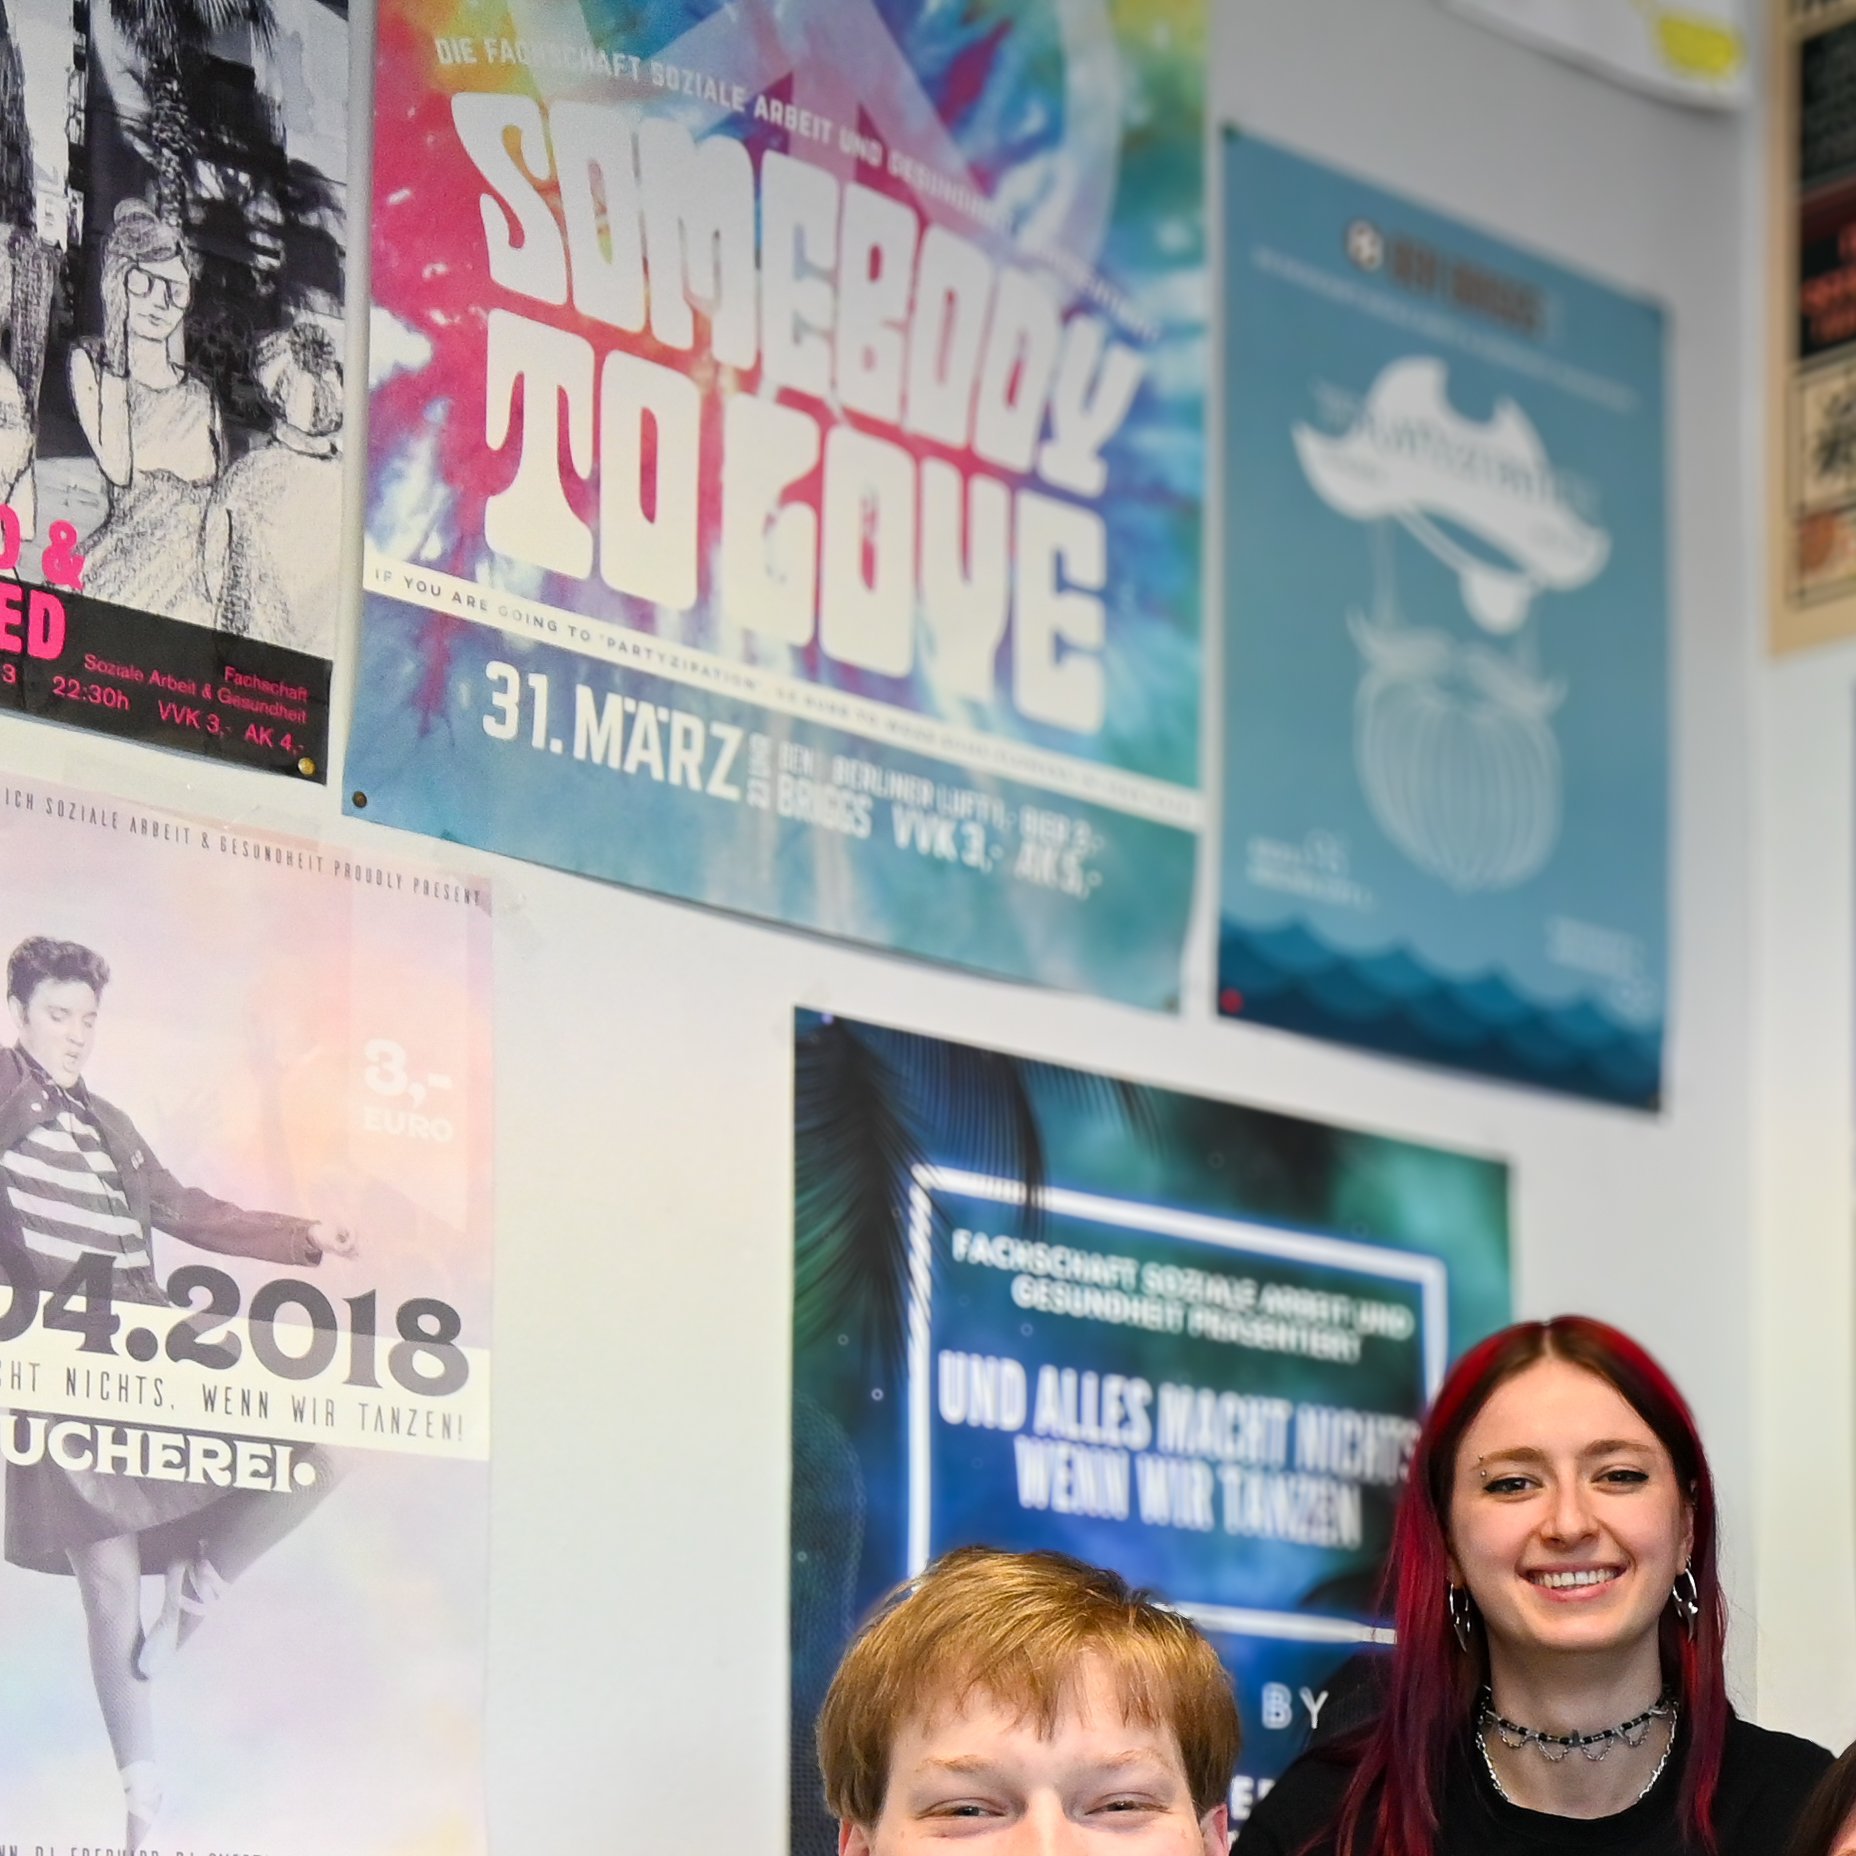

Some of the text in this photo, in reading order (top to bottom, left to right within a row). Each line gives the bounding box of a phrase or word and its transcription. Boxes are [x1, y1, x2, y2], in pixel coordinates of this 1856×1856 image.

[434, 36, 883, 166] DIE FACHSCHAFT SOZIALE ARBEIT UND
[450, 89, 1148, 497] SOMEBODY
[484, 306, 703, 612] TO
[42, 519, 86, 591] &
[374, 568, 592, 643] IF YOU ARE GOING TO
[52, 675, 274, 749] 22:30h VVK AK
[83, 653, 308, 725] Soziale Arbeit & Gesundheit
[223, 665, 310, 705] Fachschaft
[482, 658, 565, 756] 31.
[573, 681, 745, 803] MÄRZ
[777, 773, 958, 863] BRIGGS VVK
[831, 755, 936, 808] BERLINER
[45, 797, 119, 830] SOZIALE
[129, 815, 191, 845] ARBEIT
[200, 831, 211, 850] &
[219, 835, 324, 875] GESUNDHEIT
[334, 860, 402, 891] PROUDLY
[363, 1037, 453, 1110] 3,-
[362, 1104, 454, 1143] EURO
[952, 1227, 1259, 1311] FACHSCHAFT SOZIALE
[1011, 1273, 1186, 1335] GESUNDHEIT
[201, 1383, 269, 1420] WENN
[291, 1394, 336, 1428] WIR
[358, 1402, 465, 1442] TANZEN!
[938, 1348, 1028, 1433] UND
[1032, 1363, 1153, 1451] ALLES
[1157, 1381, 1294, 1470] MACHT
[1013, 1433, 1363, 1552] WENN WIR TANZEN
[1261, 1681, 1329, 1730] BY
